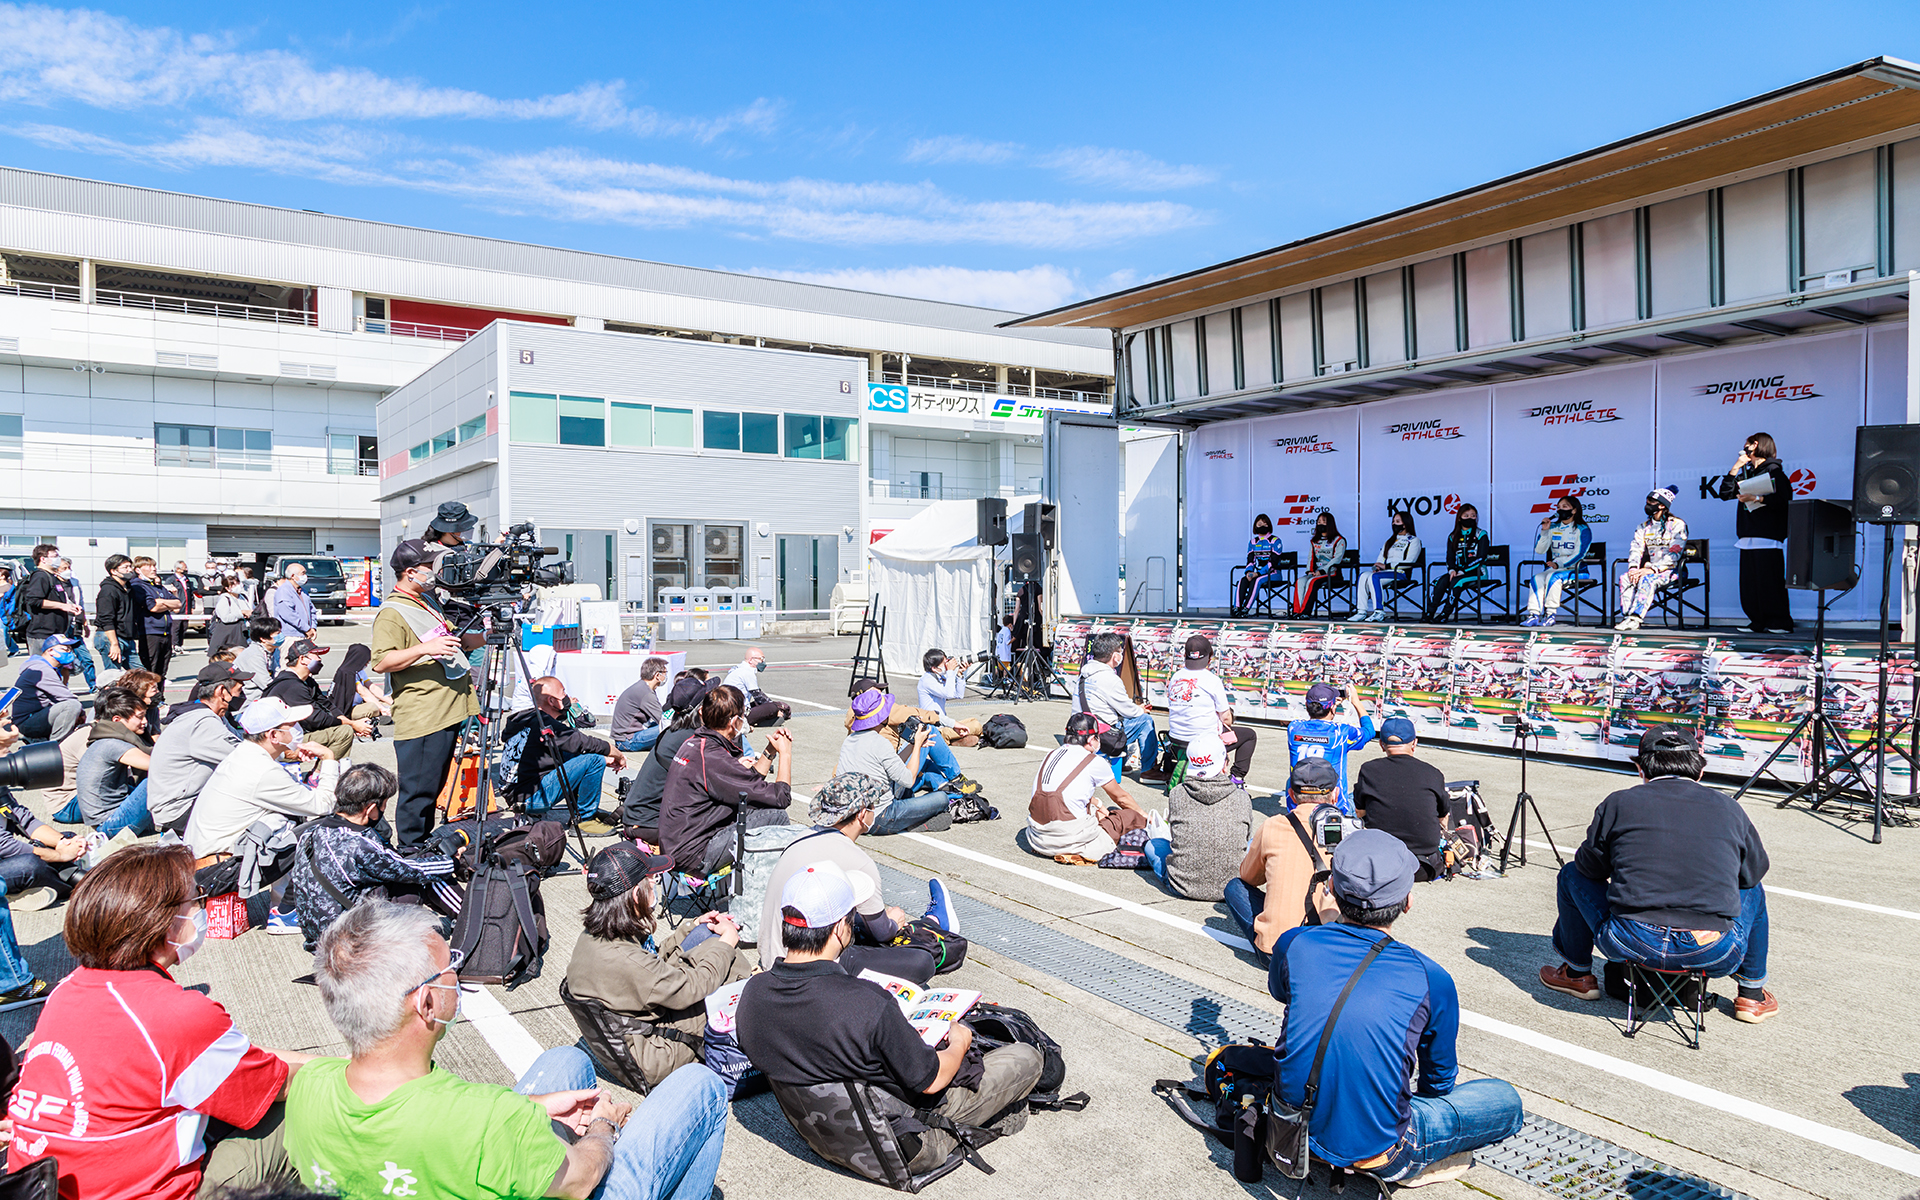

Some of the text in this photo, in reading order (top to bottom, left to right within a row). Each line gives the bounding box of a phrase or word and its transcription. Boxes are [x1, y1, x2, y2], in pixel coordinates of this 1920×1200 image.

[522, 351, 532, 364] 5
[842, 381, 850, 393] 6
[1705, 375, 1785, 394] DRIVING
[1722, 384, 1815, 405] ATHLETE
[911, 393, 980, 415] オティックス
[1530, 400, 1593, 417] DRIVING
[1544, 408, 1617, 426] ATHLETE
[1390, 419, 1441, 434] DRIVING
[1402, 426, 1460, 441] ATHLETE
[1276, 435, 1319, 447] DRIVING
[1285, 441, 1334, 454] ATHLETE
[1700, 637, 1717, 690] DRIVING
[1189, 754, 1212, 764] NGK
[721, 1060, 753, 1073] ALWAYS
